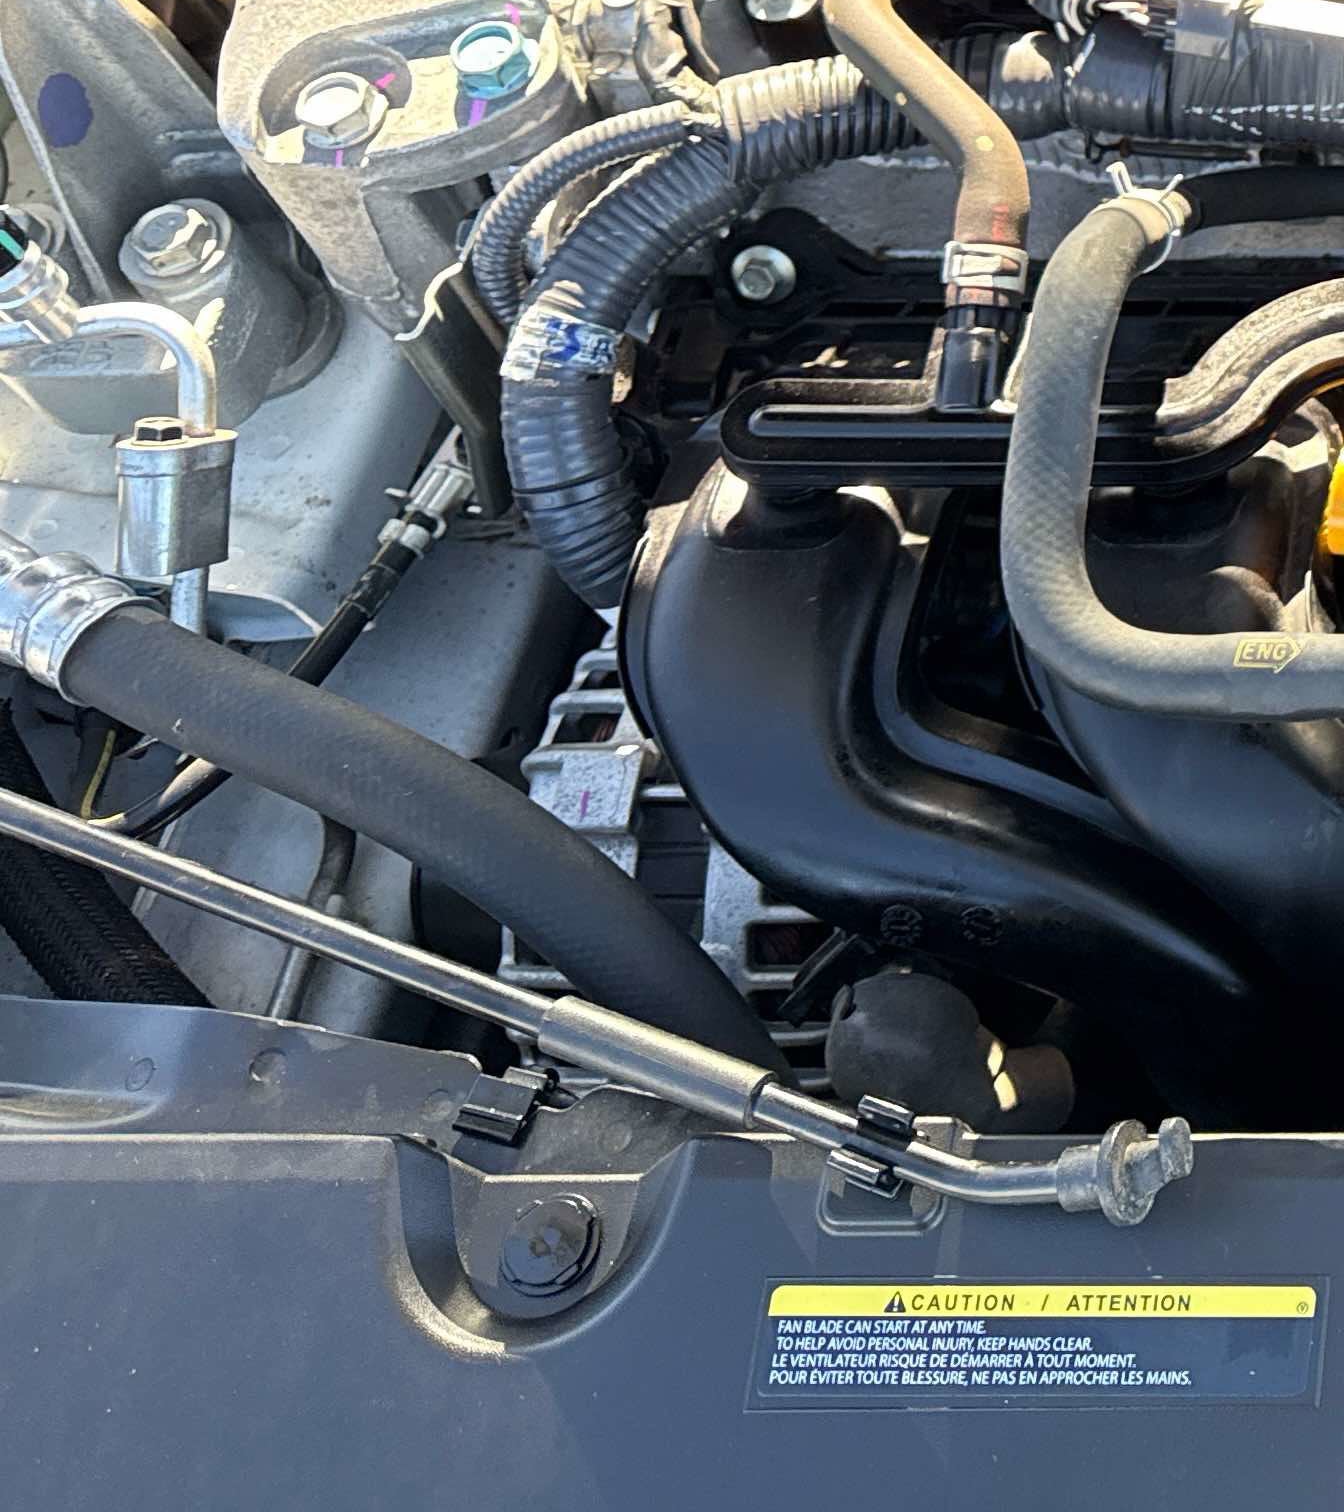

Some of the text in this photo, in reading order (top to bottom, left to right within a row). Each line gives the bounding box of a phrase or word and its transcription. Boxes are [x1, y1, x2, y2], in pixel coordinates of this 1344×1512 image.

[1241, 641, 1288, 661] ENG
[911, 1294, 1015, 1311] CAUTION
[1066, 1295, 1192, 1311] ATTENTION
[778, 1320, 803, 1334] FAN
[804, 1320, 844, 1334] BLADE
[845, 1320, 873, 1334] CAN
[874, 1320, 909, 1334] START
[911, 1320, 927, 1334] AT
[928, 1321, 957, 1334] ANY
[777, 1337, 793, 1350] TO
[795, 1337, 826, 1350] HELP
[828, 1337, 866, 1350] AVOID
[867, 1337, 930, 1351] PERSONAL
[931, 1337, 975, 1353] INJURY,
[977, 1337, 1006, 1351] KEEP
[1008, 1337, 1051, 1351] HANDS
[772, 1352, 1136, 1370] LE VENTILATEUR RISQUE DE DÉMARRER À TOUT MOMENT.
[769, 1369, 1192, 1387] POUR ÉVITER TOUTE BLESSURE, NE PAS EN APPROCHER LES MAINS.
